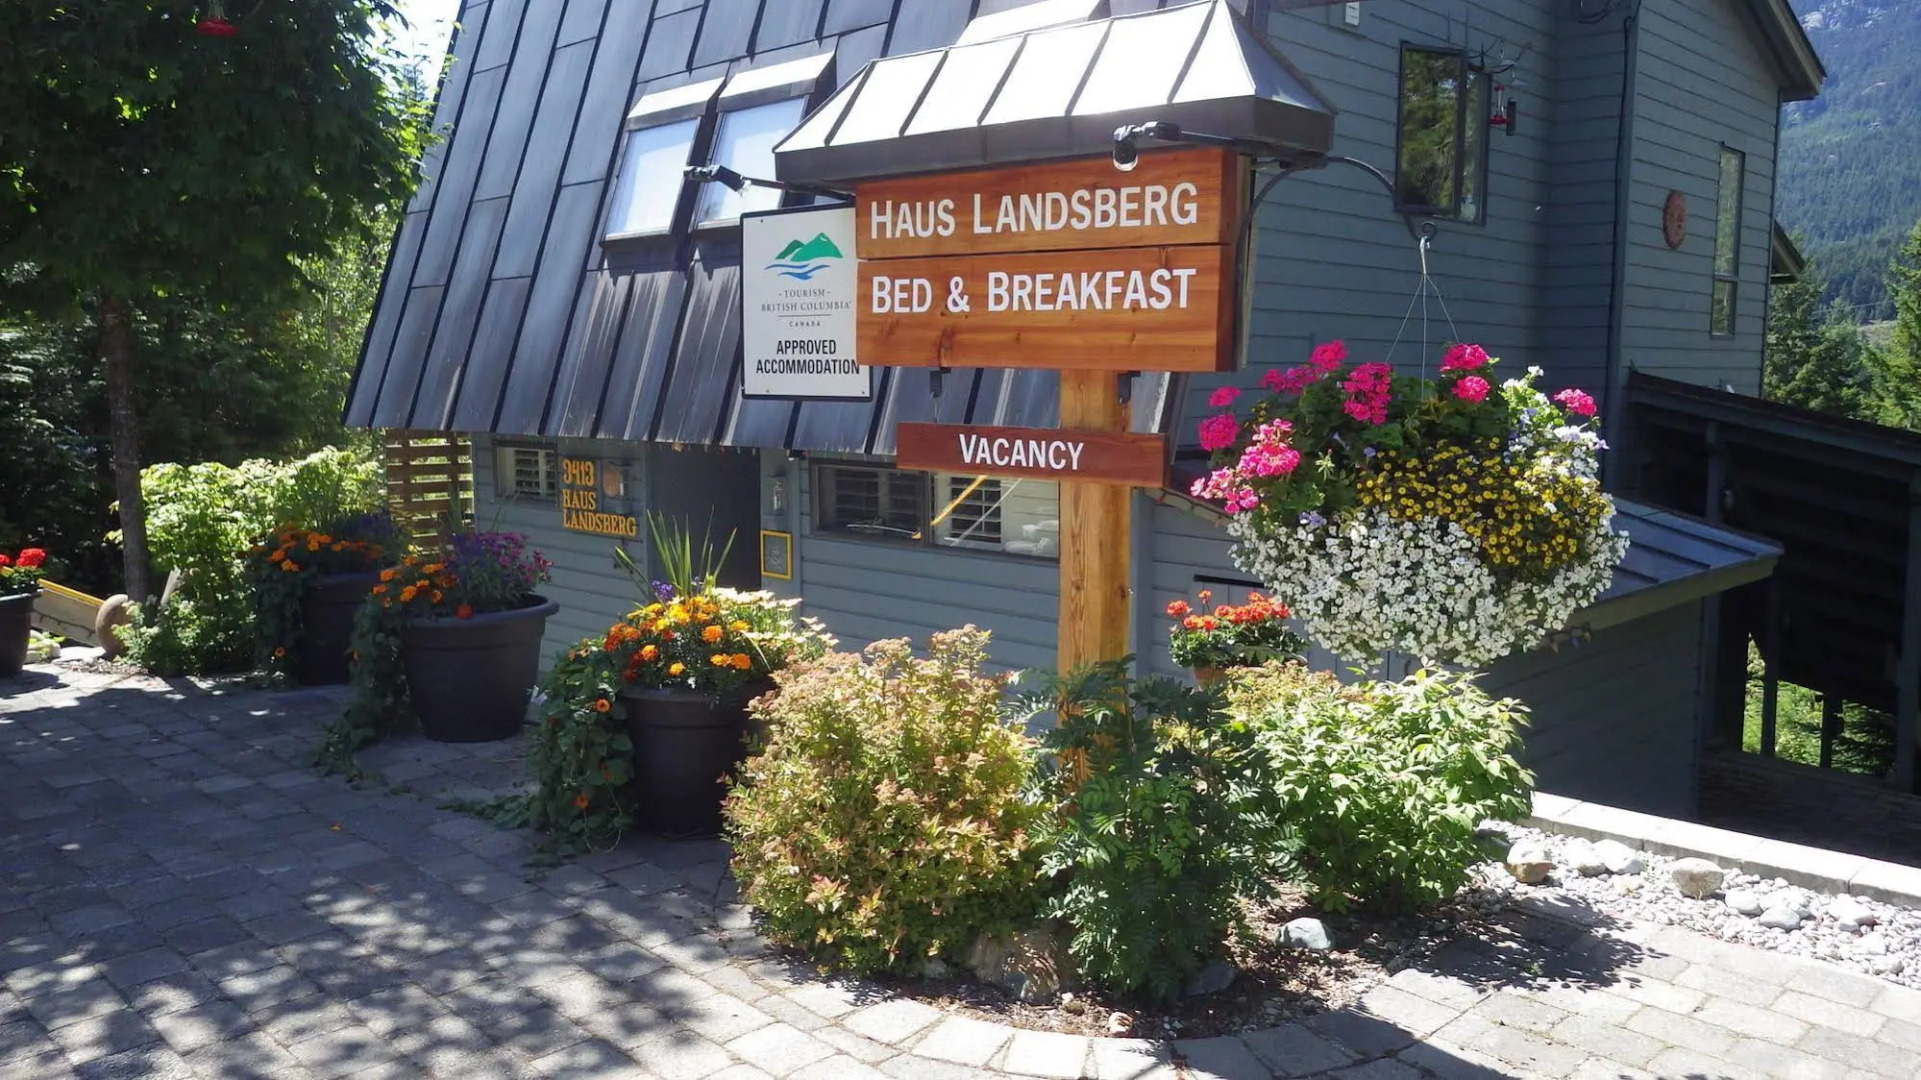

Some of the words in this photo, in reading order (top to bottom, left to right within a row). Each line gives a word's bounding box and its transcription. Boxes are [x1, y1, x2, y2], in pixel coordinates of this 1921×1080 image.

[870, 198, 956, 239] HAUS
[973, 182, 1198, 235] LANDSBERG
[784, 289, 825, 298] TOURISM
[872, 276, 932, 313] BED
[946, 276, 970, 313] &
[988, 268, 1197, 312] BREAKFAST
[761, 302, 797, 312] BRITISH
[800, 301, 850, 311] COLUMBIA
[789, 320, 821, 328] CANADA
[776, 339, 837, 355] APPROVED
[756, 359, 860, 375] ACCOMMODATION
[959, 434, 1084, 470] VACANCY
[563, 459, 594, 486] 3413
[561, 489, 596, 510] HAUS
[563, 509, 637, 537] LANDSBERG
